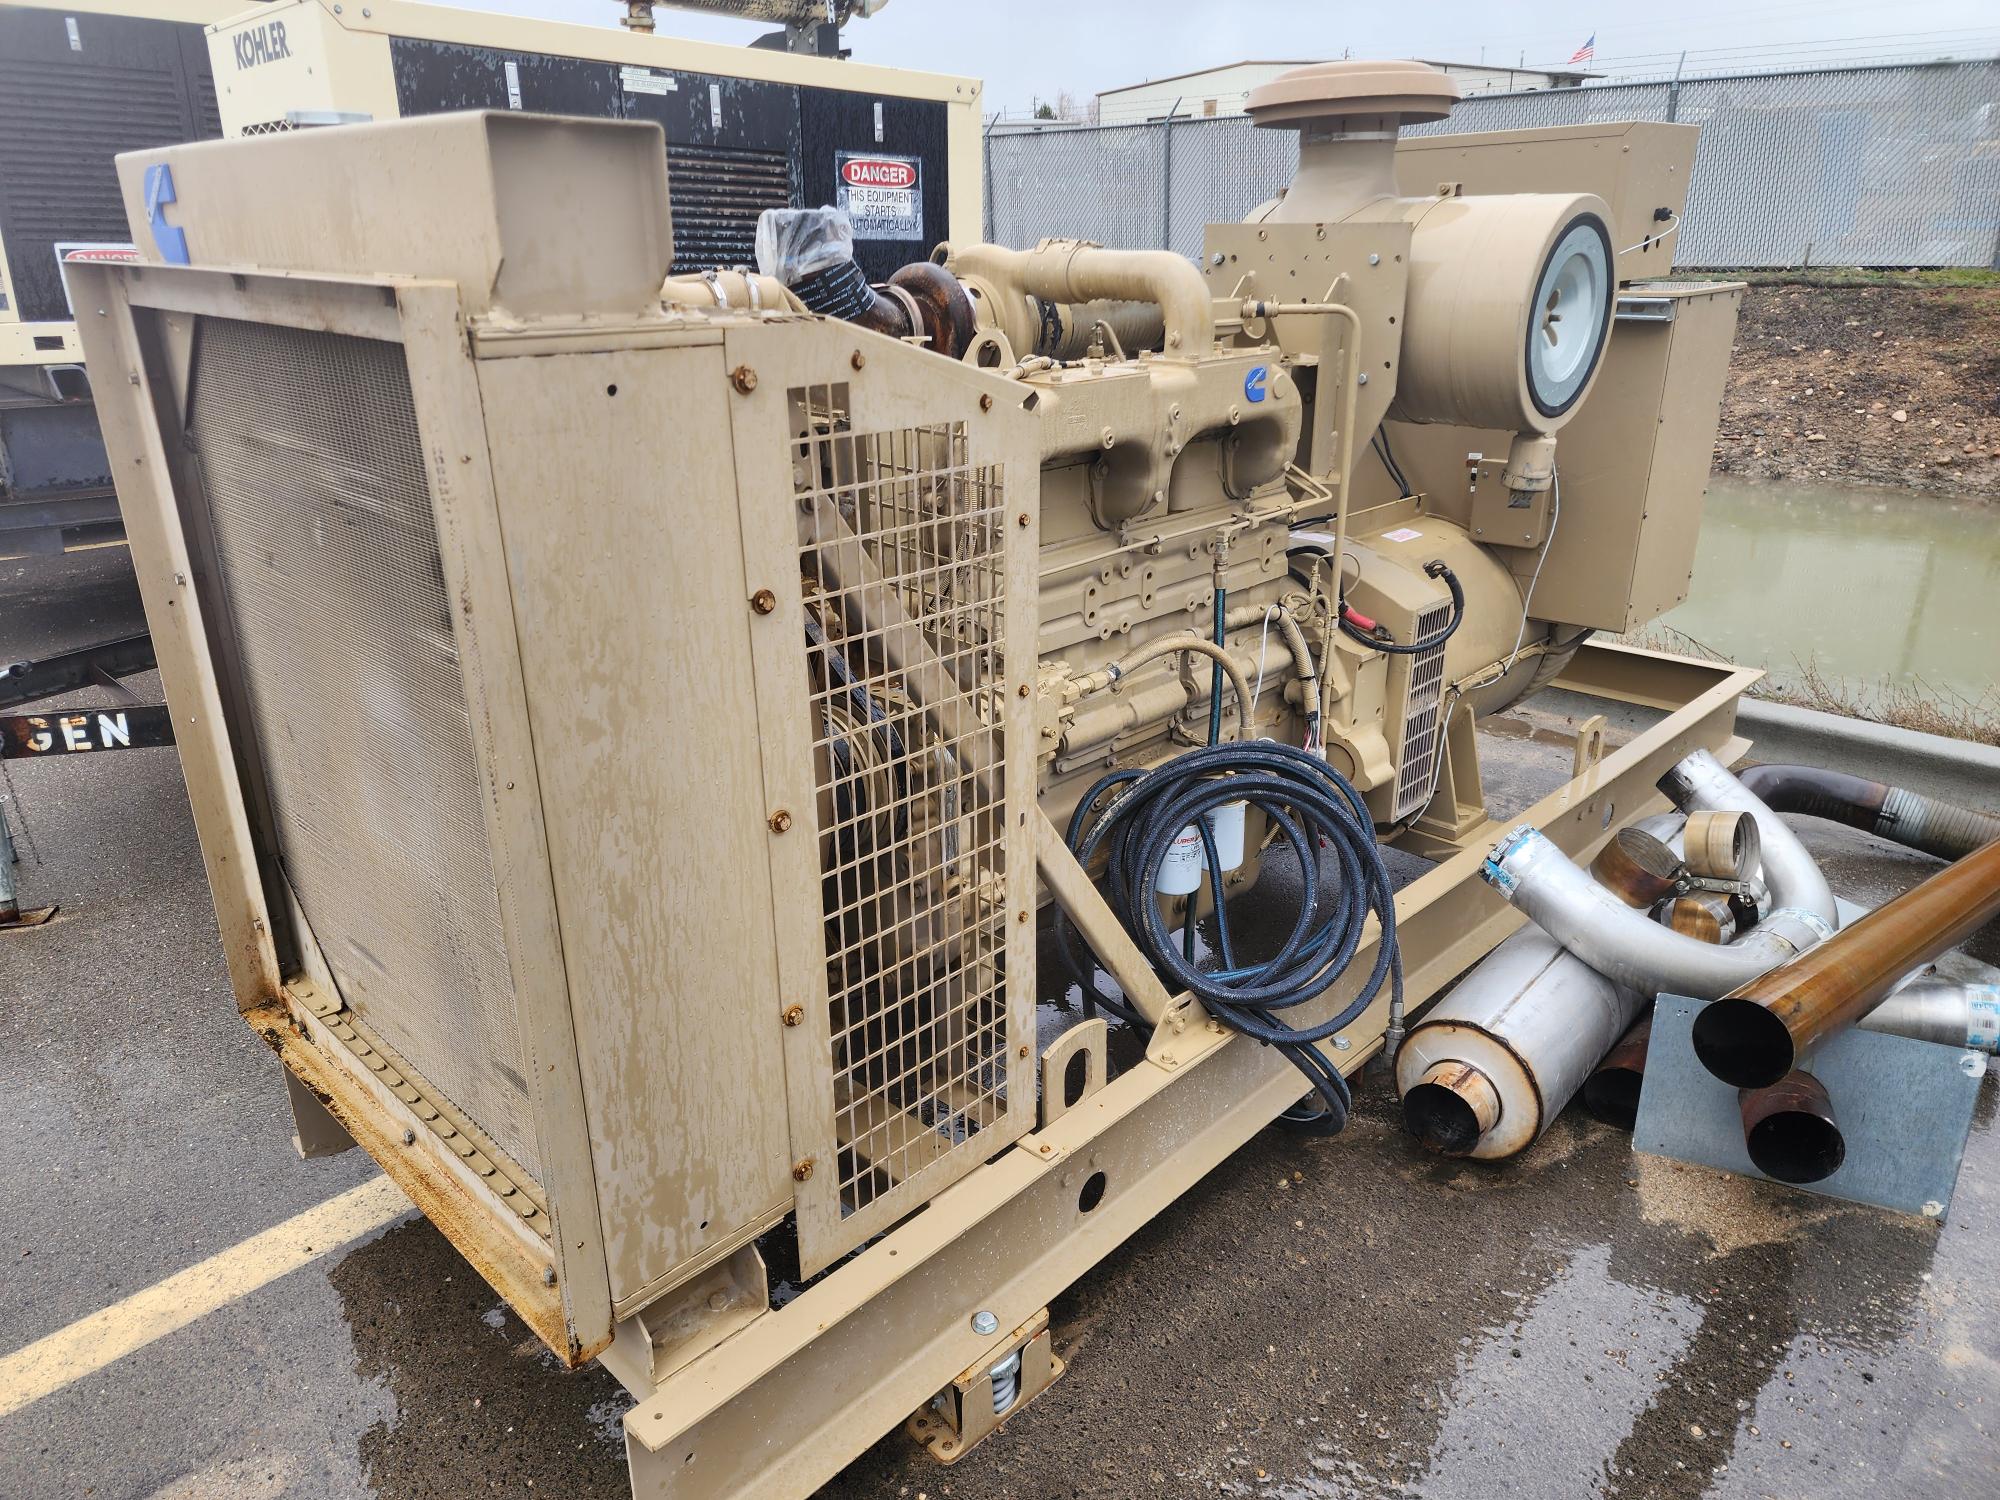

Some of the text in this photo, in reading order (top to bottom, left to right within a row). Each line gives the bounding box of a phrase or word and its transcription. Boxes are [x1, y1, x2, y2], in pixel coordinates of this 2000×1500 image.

[232, 20, 291, 71] KOHLER
[850, 164, 908, 183] DANGER
[847, 189, 913, 204] THIS EQUIPMENT
[864, 204, 897, 217] STARTS
[26, 713, 131, 751] GEN
